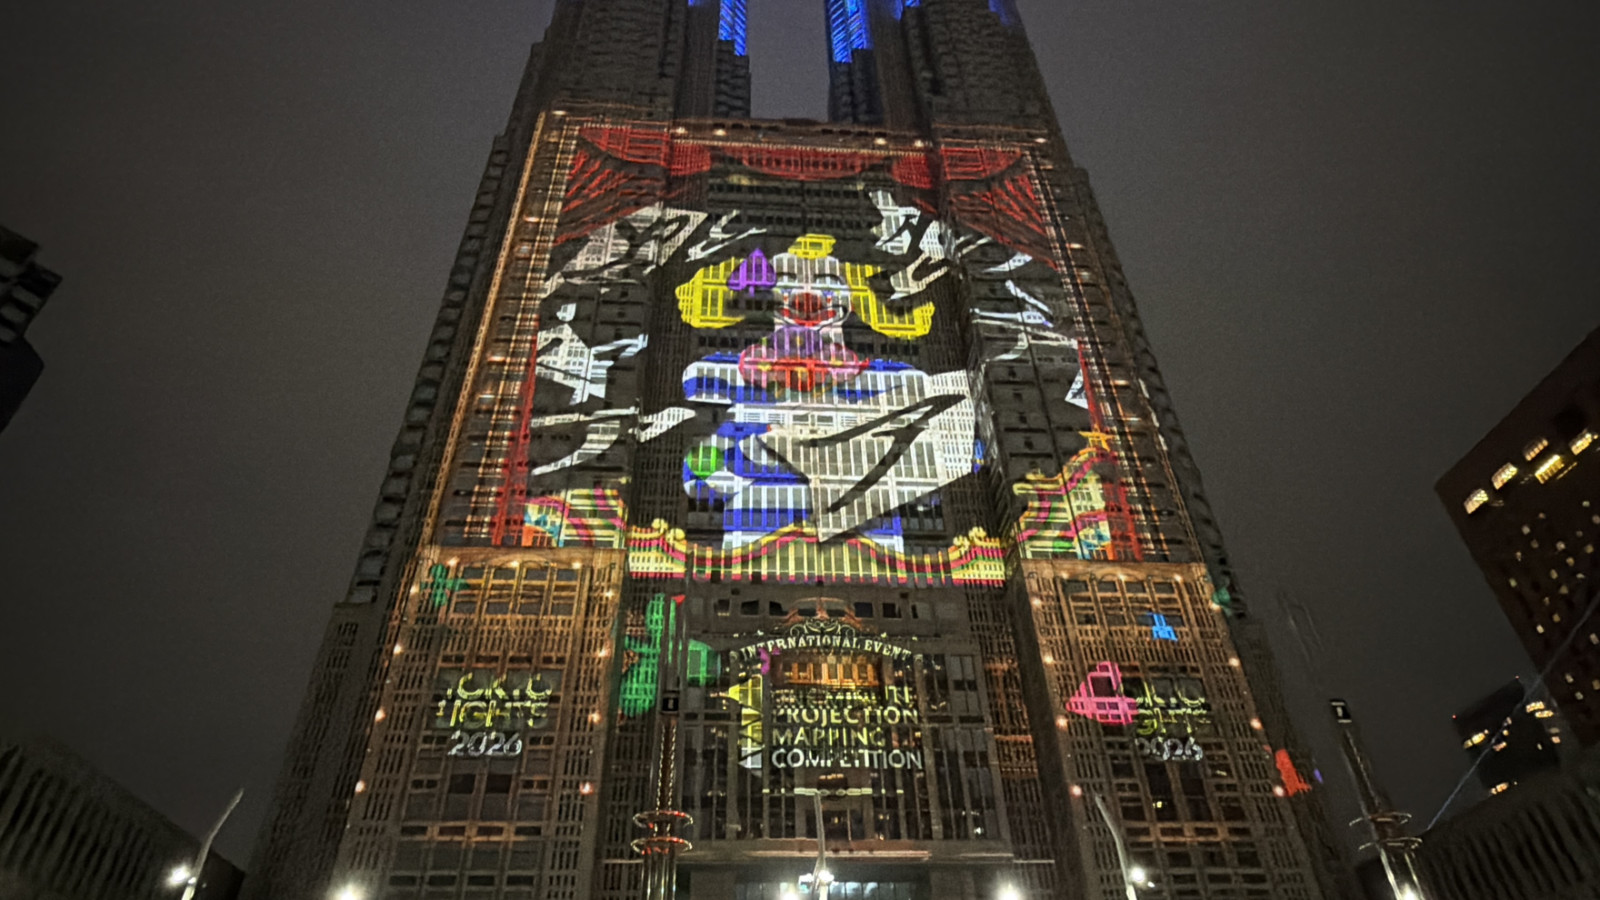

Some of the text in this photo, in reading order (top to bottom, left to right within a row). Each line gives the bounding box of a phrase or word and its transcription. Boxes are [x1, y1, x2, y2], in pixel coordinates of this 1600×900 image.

[740, 635, 912, 661] INTERNATIONAL EVENT
[772, 704, 919, 727] PROJECTION
[448, 730, 523, 756] 2026
[772, 726, 886, 747] MAPPING
[772, 748, 923, 769] COMPETITION
